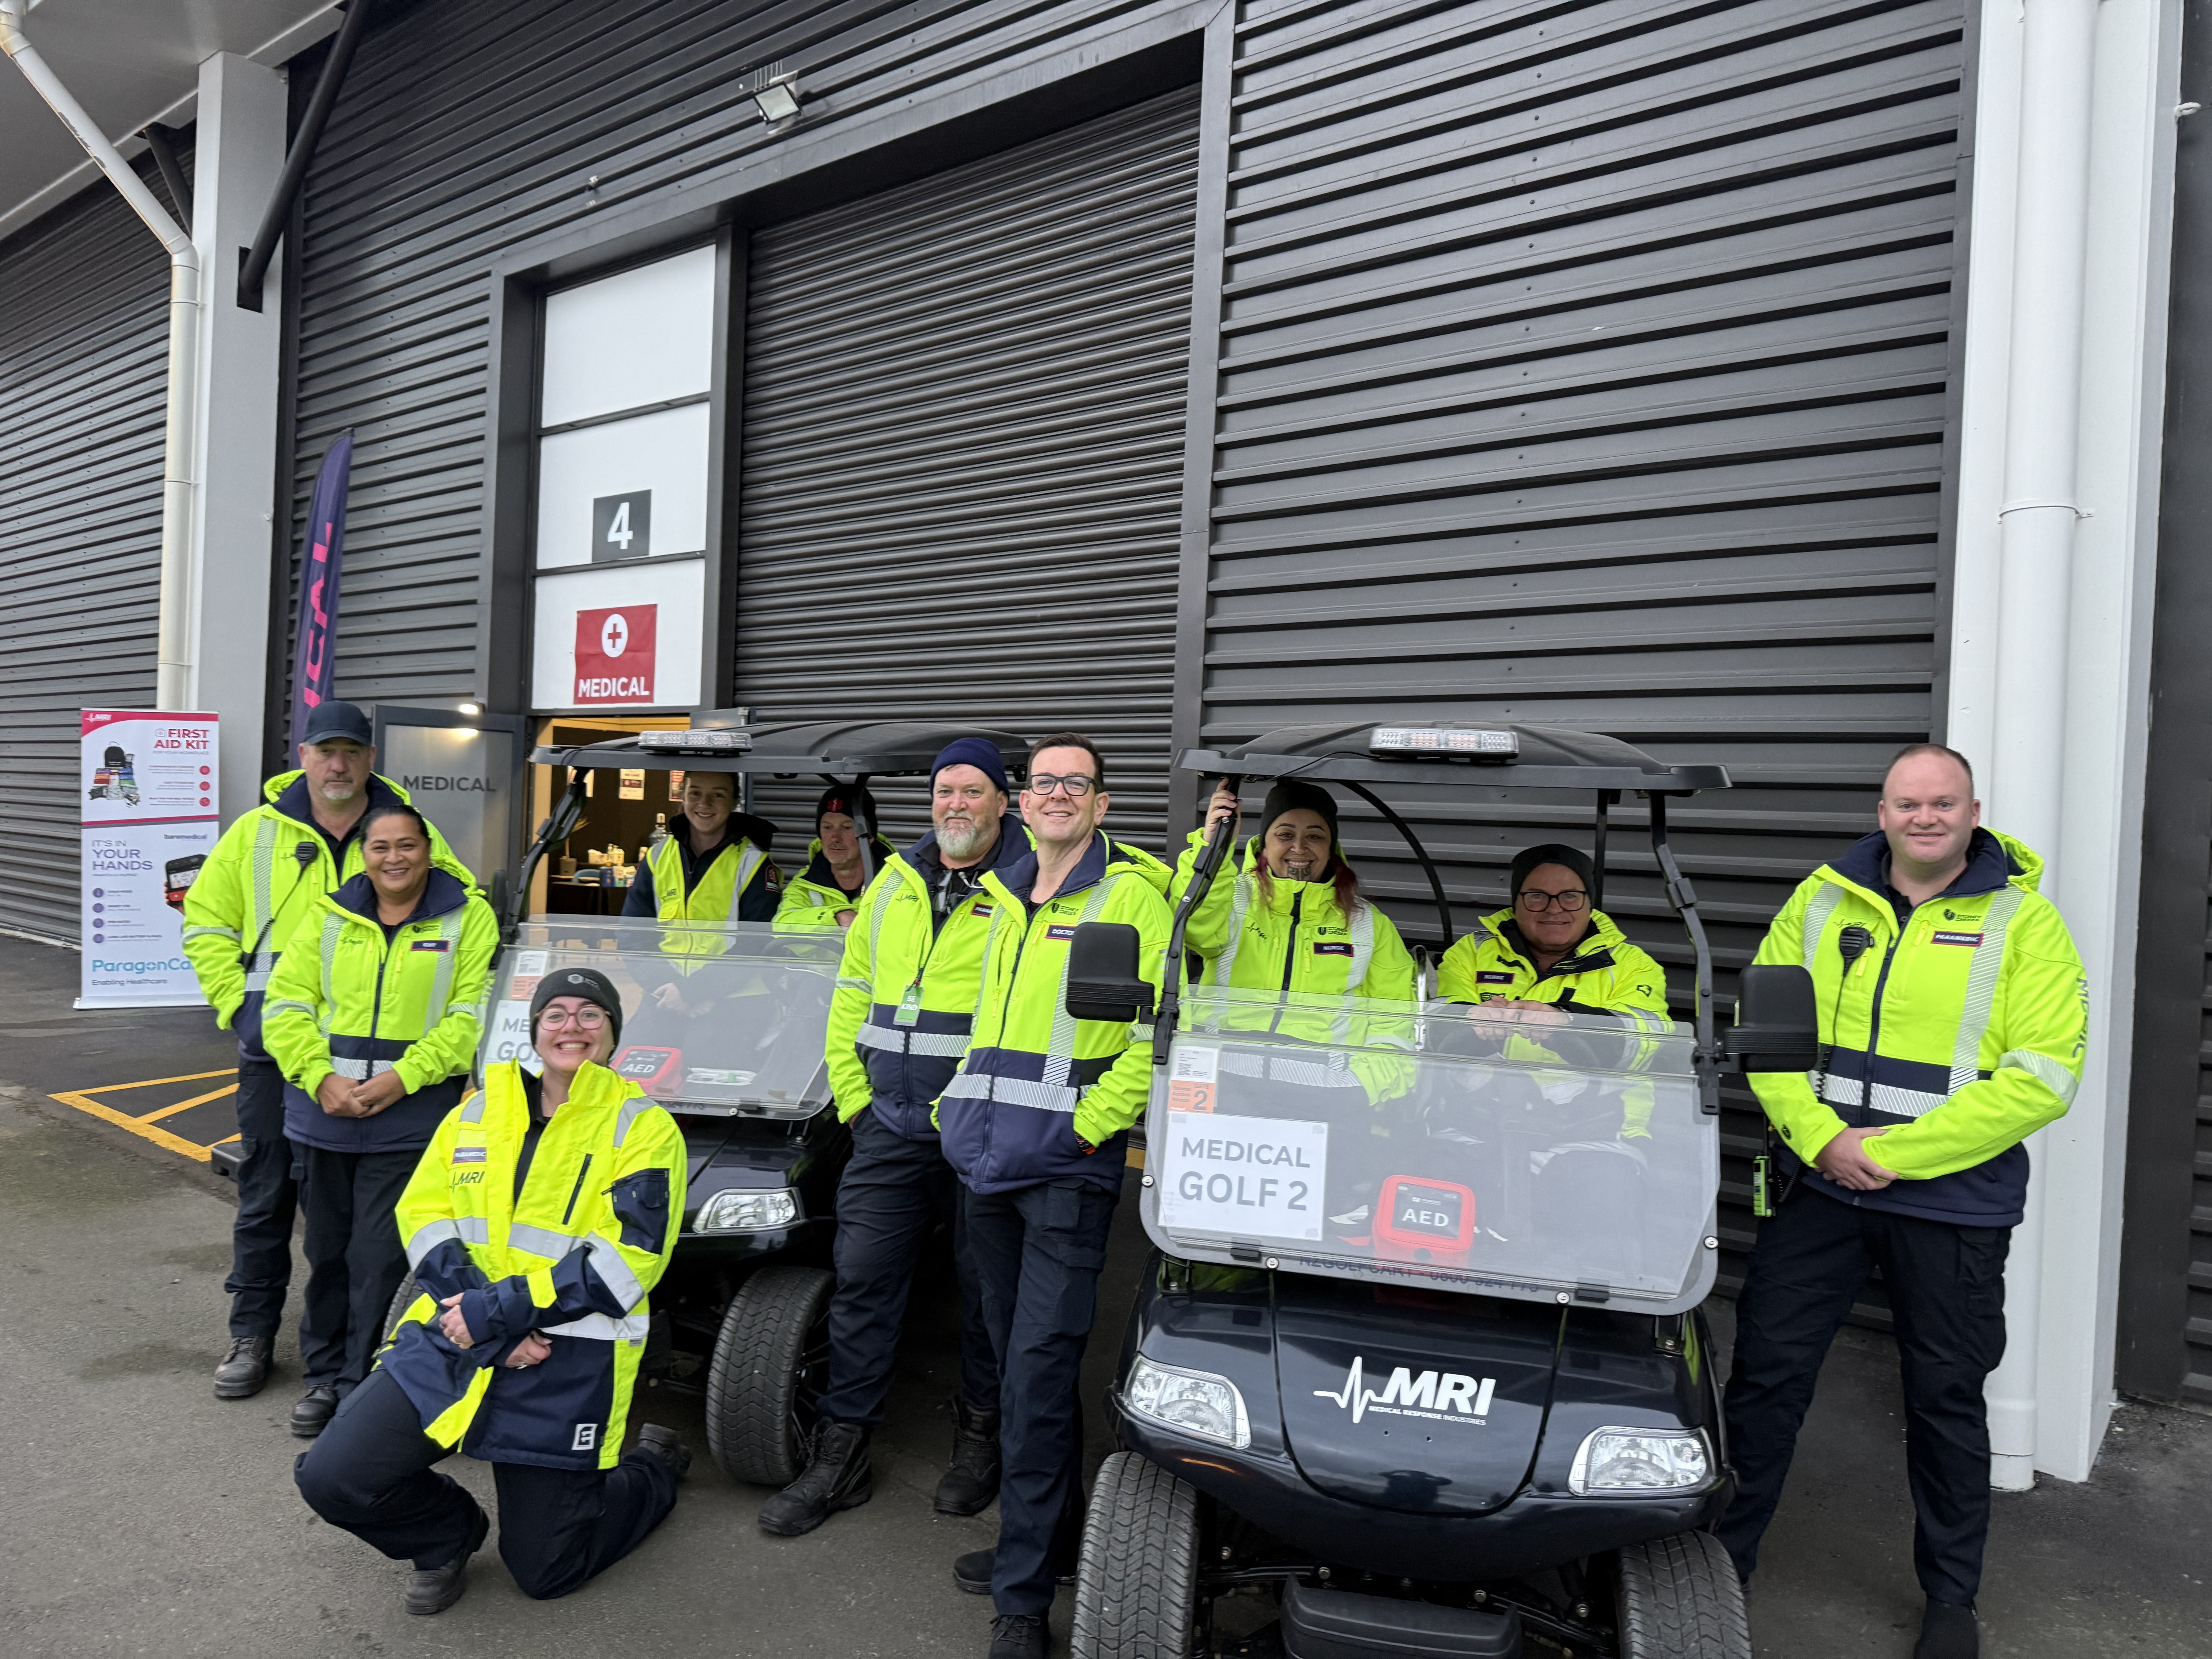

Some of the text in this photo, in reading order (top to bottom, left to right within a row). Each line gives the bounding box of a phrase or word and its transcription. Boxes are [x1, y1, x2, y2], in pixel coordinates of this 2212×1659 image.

[607, 501, 633, 550] 4
[578, 676, 650, 697] MEDICAL
[168, 728, 210, 738] FIRST
[154, 740, 210, 749] AID KIT
[403, 775, 496, 792] MEDICAL
[92, 849, 141, 859] YOUR
[92, 860, 153, 871] HANDS
[92, 958, 196, 974] ParagonCa
[622, 1063, 656, 1073] AED
[1192, 1090, 1208, 1111] 2
[1182, 1137, 1310, 1168] MEDICAL
[459, 1171, 486, 1185] MRI
[1178, 1171, 1308, 1211] GOLF 2
[1401, 1208, 1449, 1227] AED
[1382, 1367, 1496, 1415] MRI
[1368, 1406, 1486, 1425] MEDICAL RESPONSE INDUSTRIES
